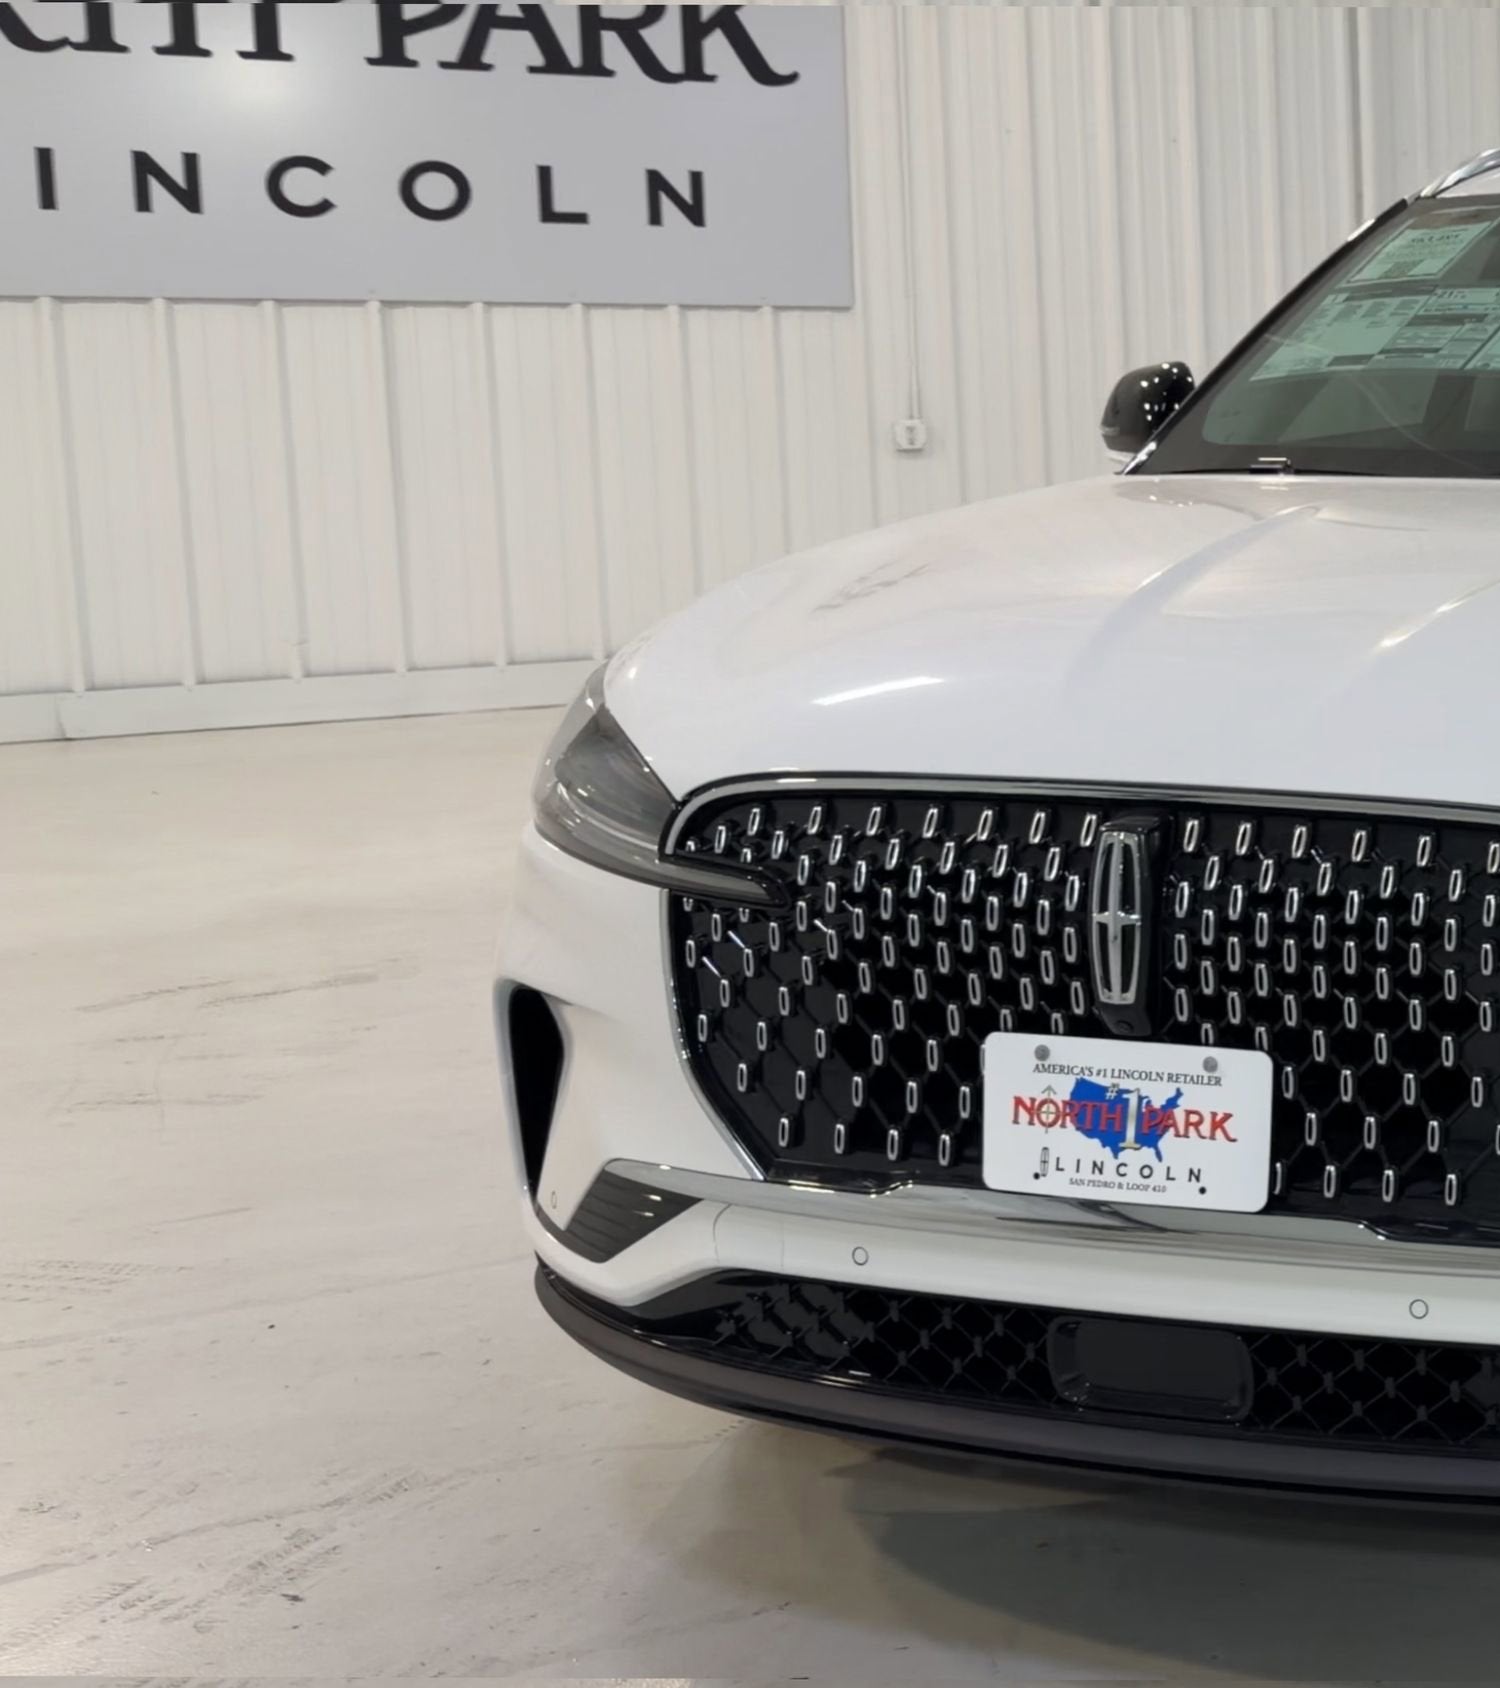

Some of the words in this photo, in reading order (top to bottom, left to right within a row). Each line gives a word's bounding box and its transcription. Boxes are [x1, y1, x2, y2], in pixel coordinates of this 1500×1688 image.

[34, 147, 707, 227] INCOLN
[1033, 1063, 1094, 1077] AMERICA'S
[1096, 1068, 1107, 1078] #1
[1110, 1068, 1165, 1082] LINCOLN
[1167, 1072, 1222, 1087] RETAILER
[1012, 1095, 1124, 1132] NORTH
[1142, 1103, 1238, 1142] PARK
[1055, 1156, 1202, 1183] LINCOLN
[1069, 1178, 1086, 1187] SAN
[1086, 1179, 1116, 1190] PEDRO
